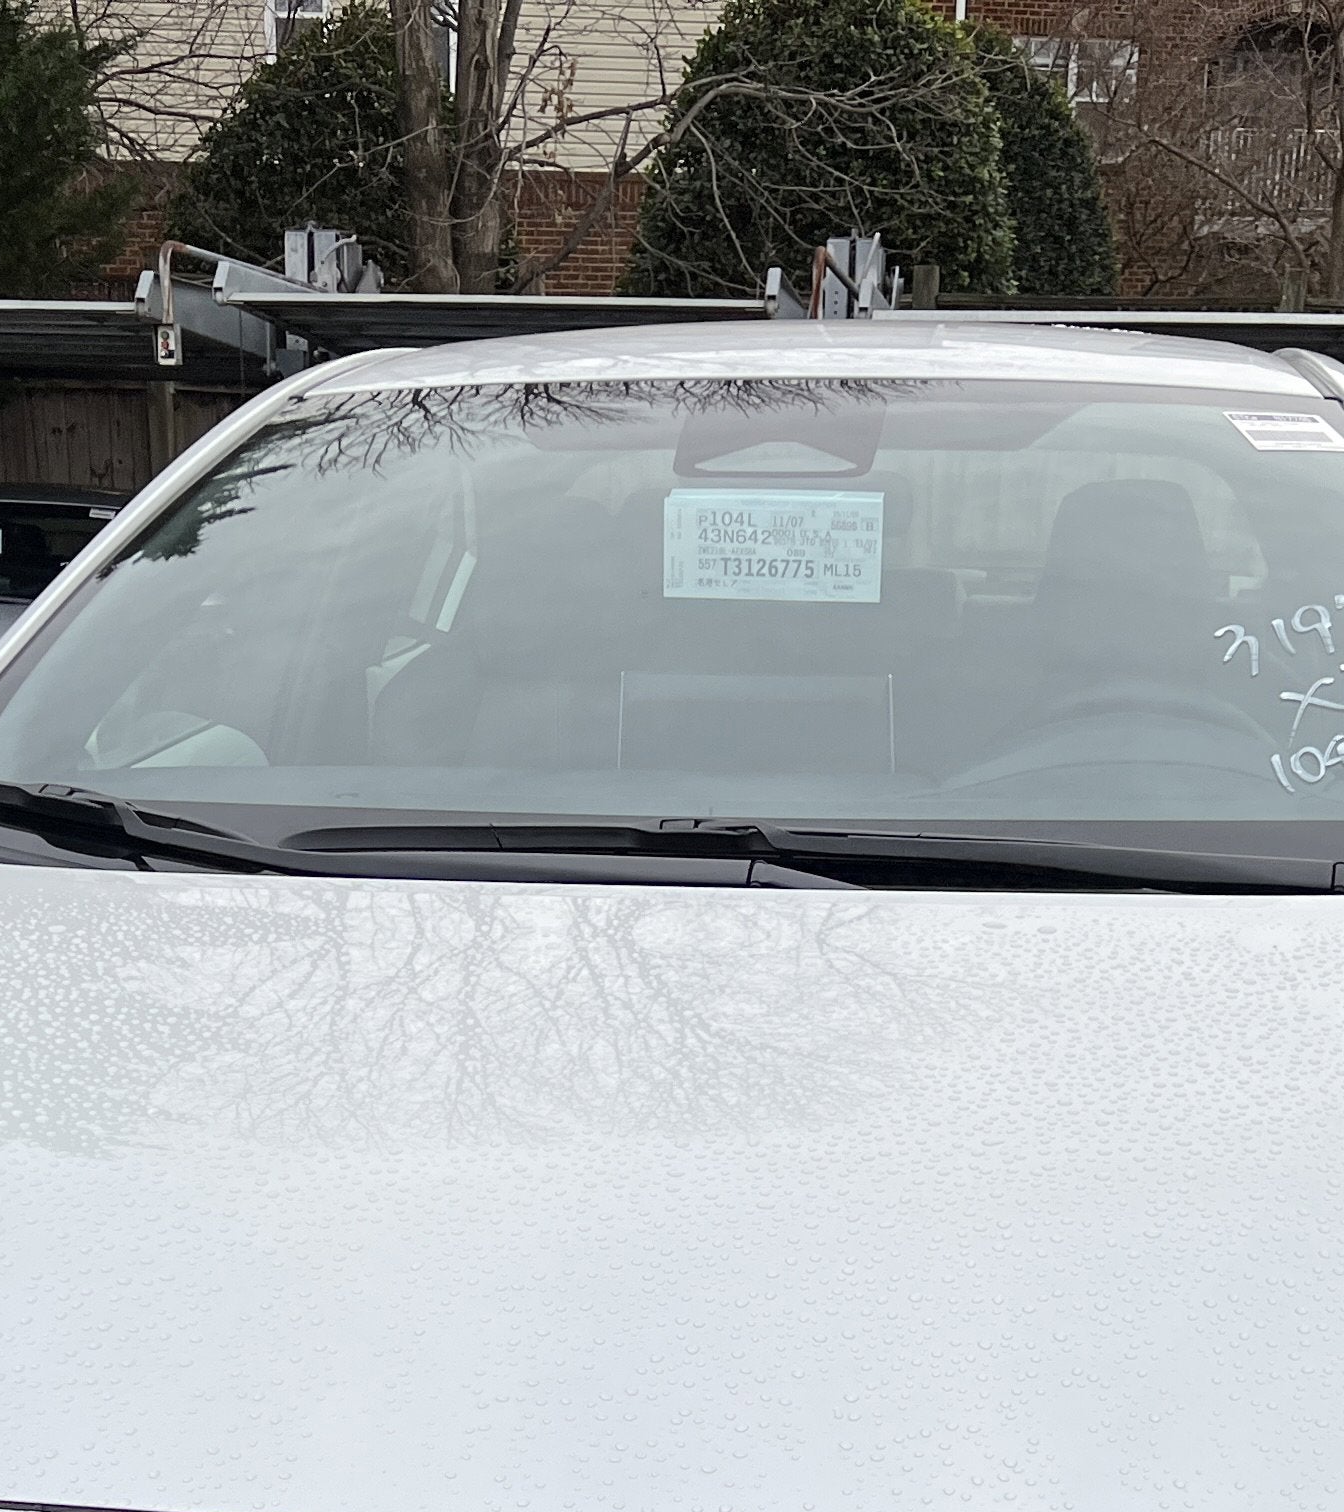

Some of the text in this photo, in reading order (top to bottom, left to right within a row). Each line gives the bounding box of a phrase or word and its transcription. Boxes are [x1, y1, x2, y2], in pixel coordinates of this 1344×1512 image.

[698, 511, 757, 527] P104L
[698, 527, 772, 545] 43N642
[720, 557, 815, 579] T3126775
[823, 562, 862, 577] ML15
